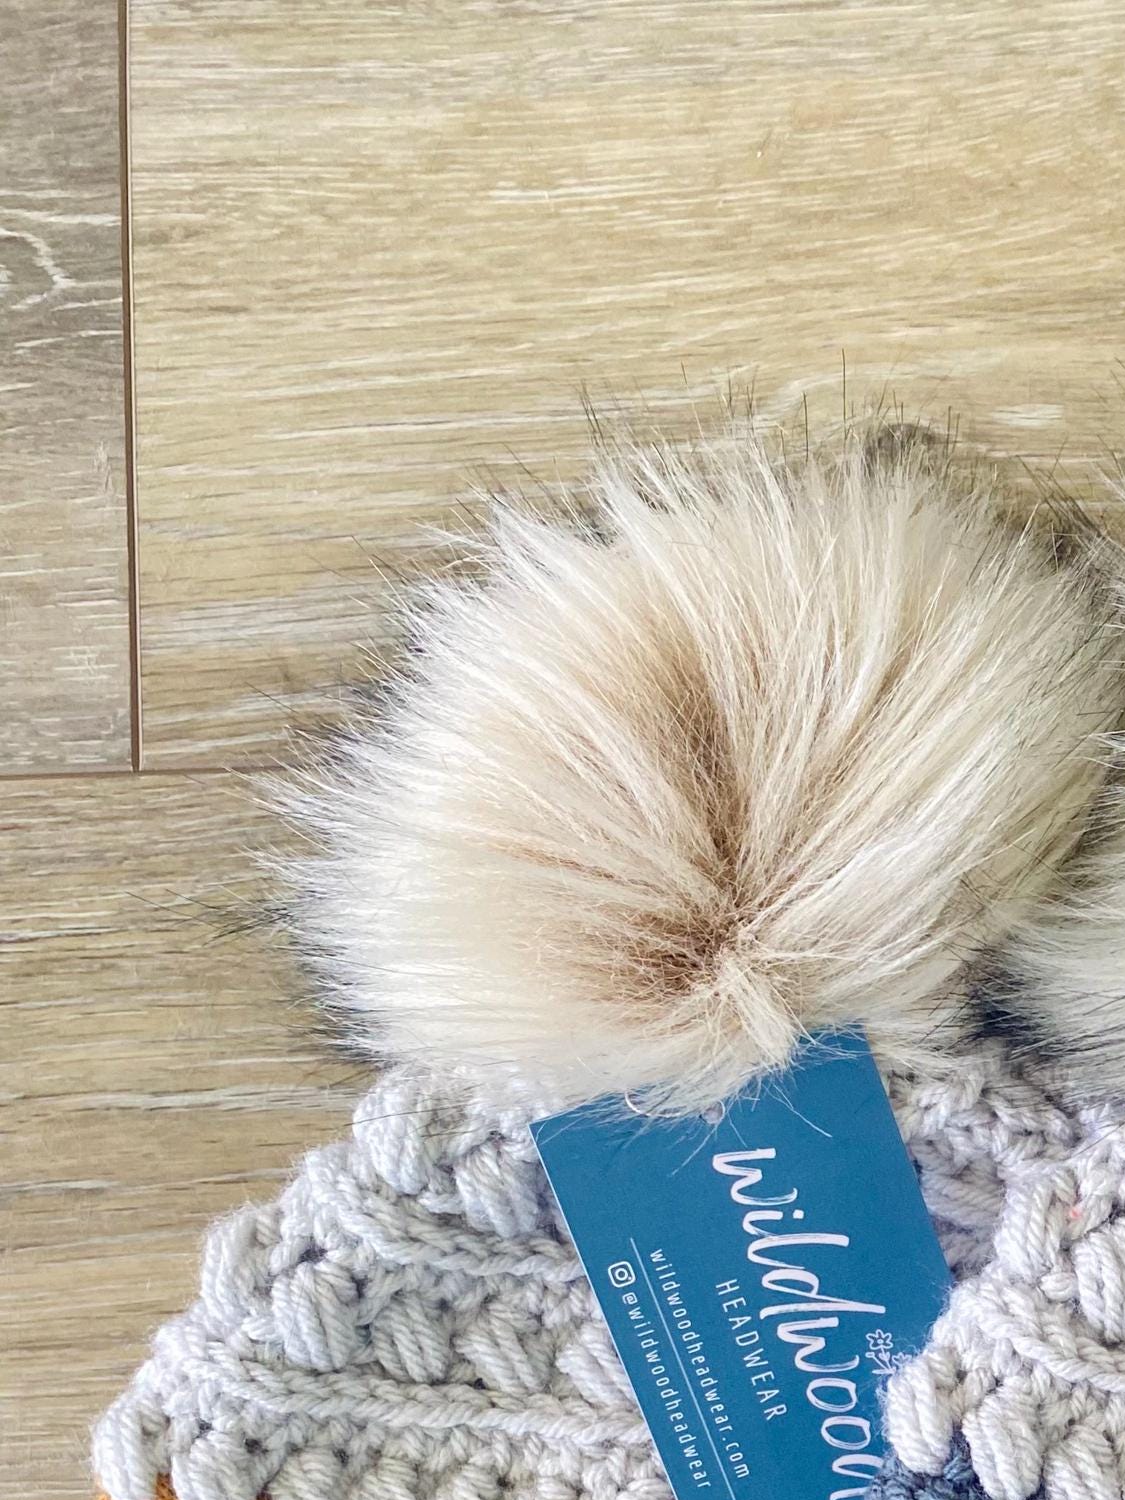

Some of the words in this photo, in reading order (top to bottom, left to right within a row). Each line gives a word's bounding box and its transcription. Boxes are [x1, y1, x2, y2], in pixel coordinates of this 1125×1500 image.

[622, 1291, 711, 1489] @wildwoodheadwear
[650, 1248, 750, 1479] wildwoodheadwear.com
[715, 1278, 788, 1421] HEADWEAR
